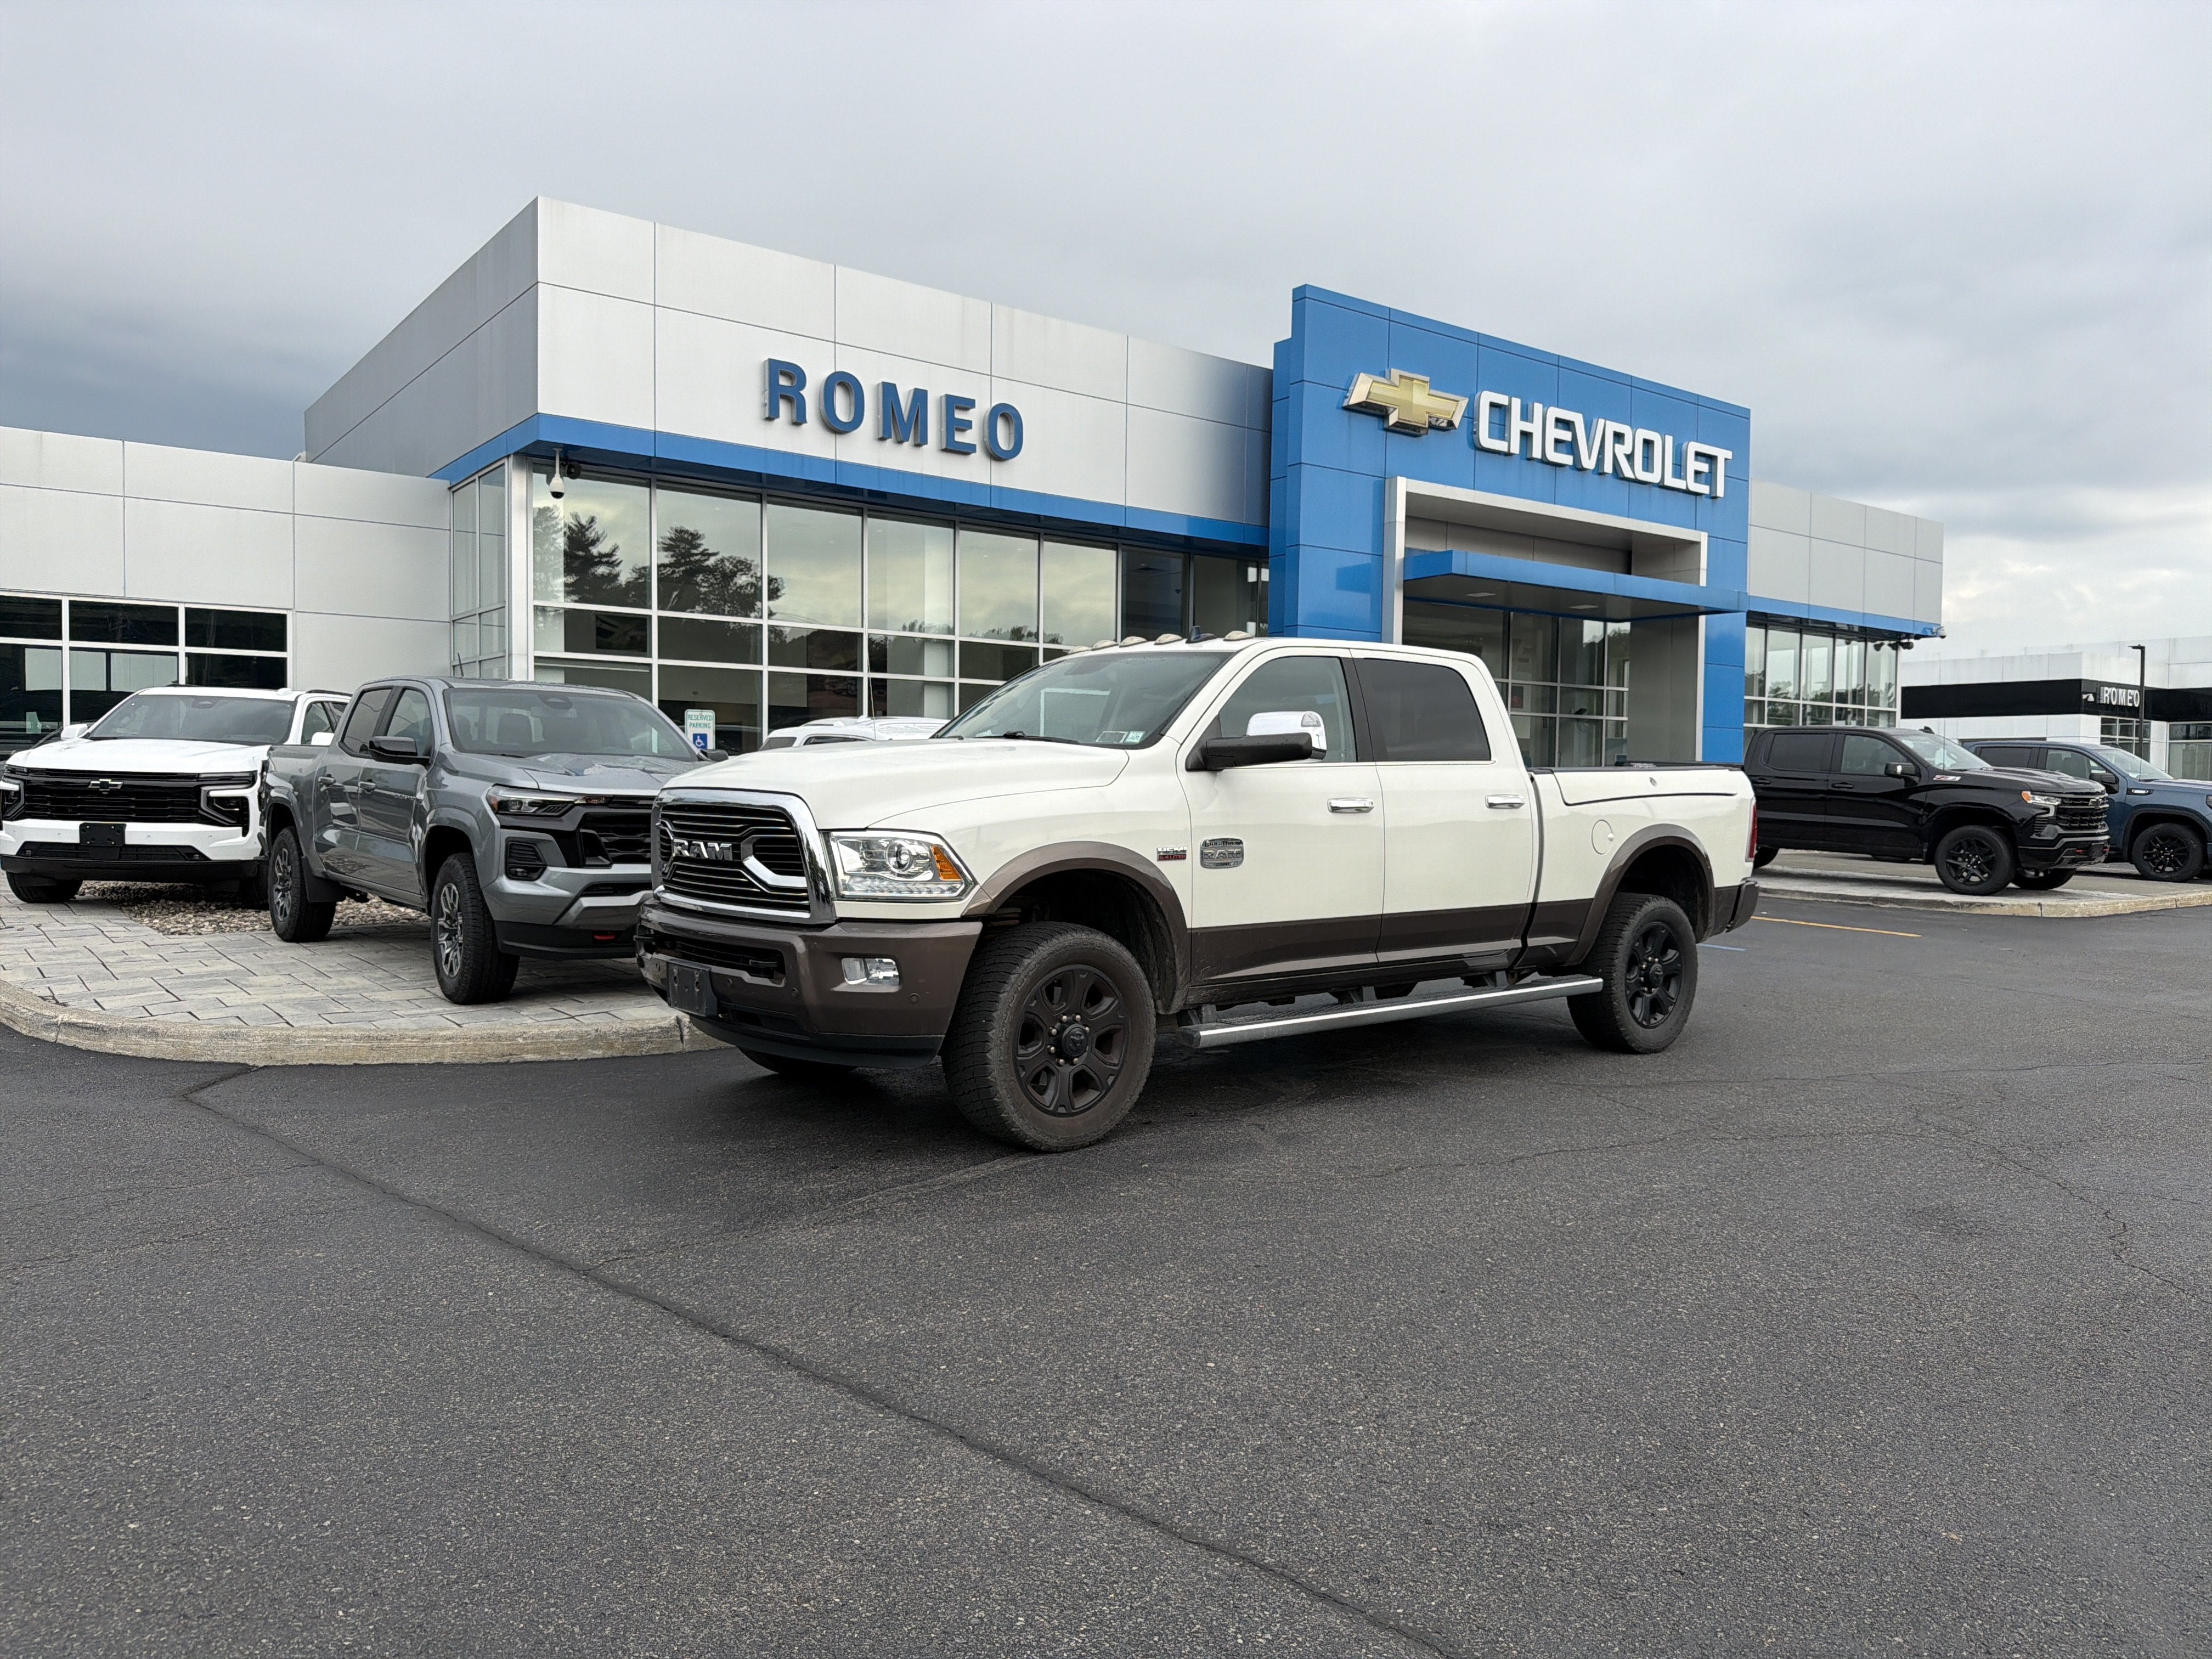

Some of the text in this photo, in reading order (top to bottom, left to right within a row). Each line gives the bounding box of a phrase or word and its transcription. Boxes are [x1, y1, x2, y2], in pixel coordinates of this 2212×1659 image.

[765, 358, 1024, 461] ROMEO
[1474, 390, 1733, 498] CHEVROLET
[2103, 686, 2140, 707] ROMEO
[674, 839, 733, 861] RAM
[1204, 849, 1241, 859] RAM
